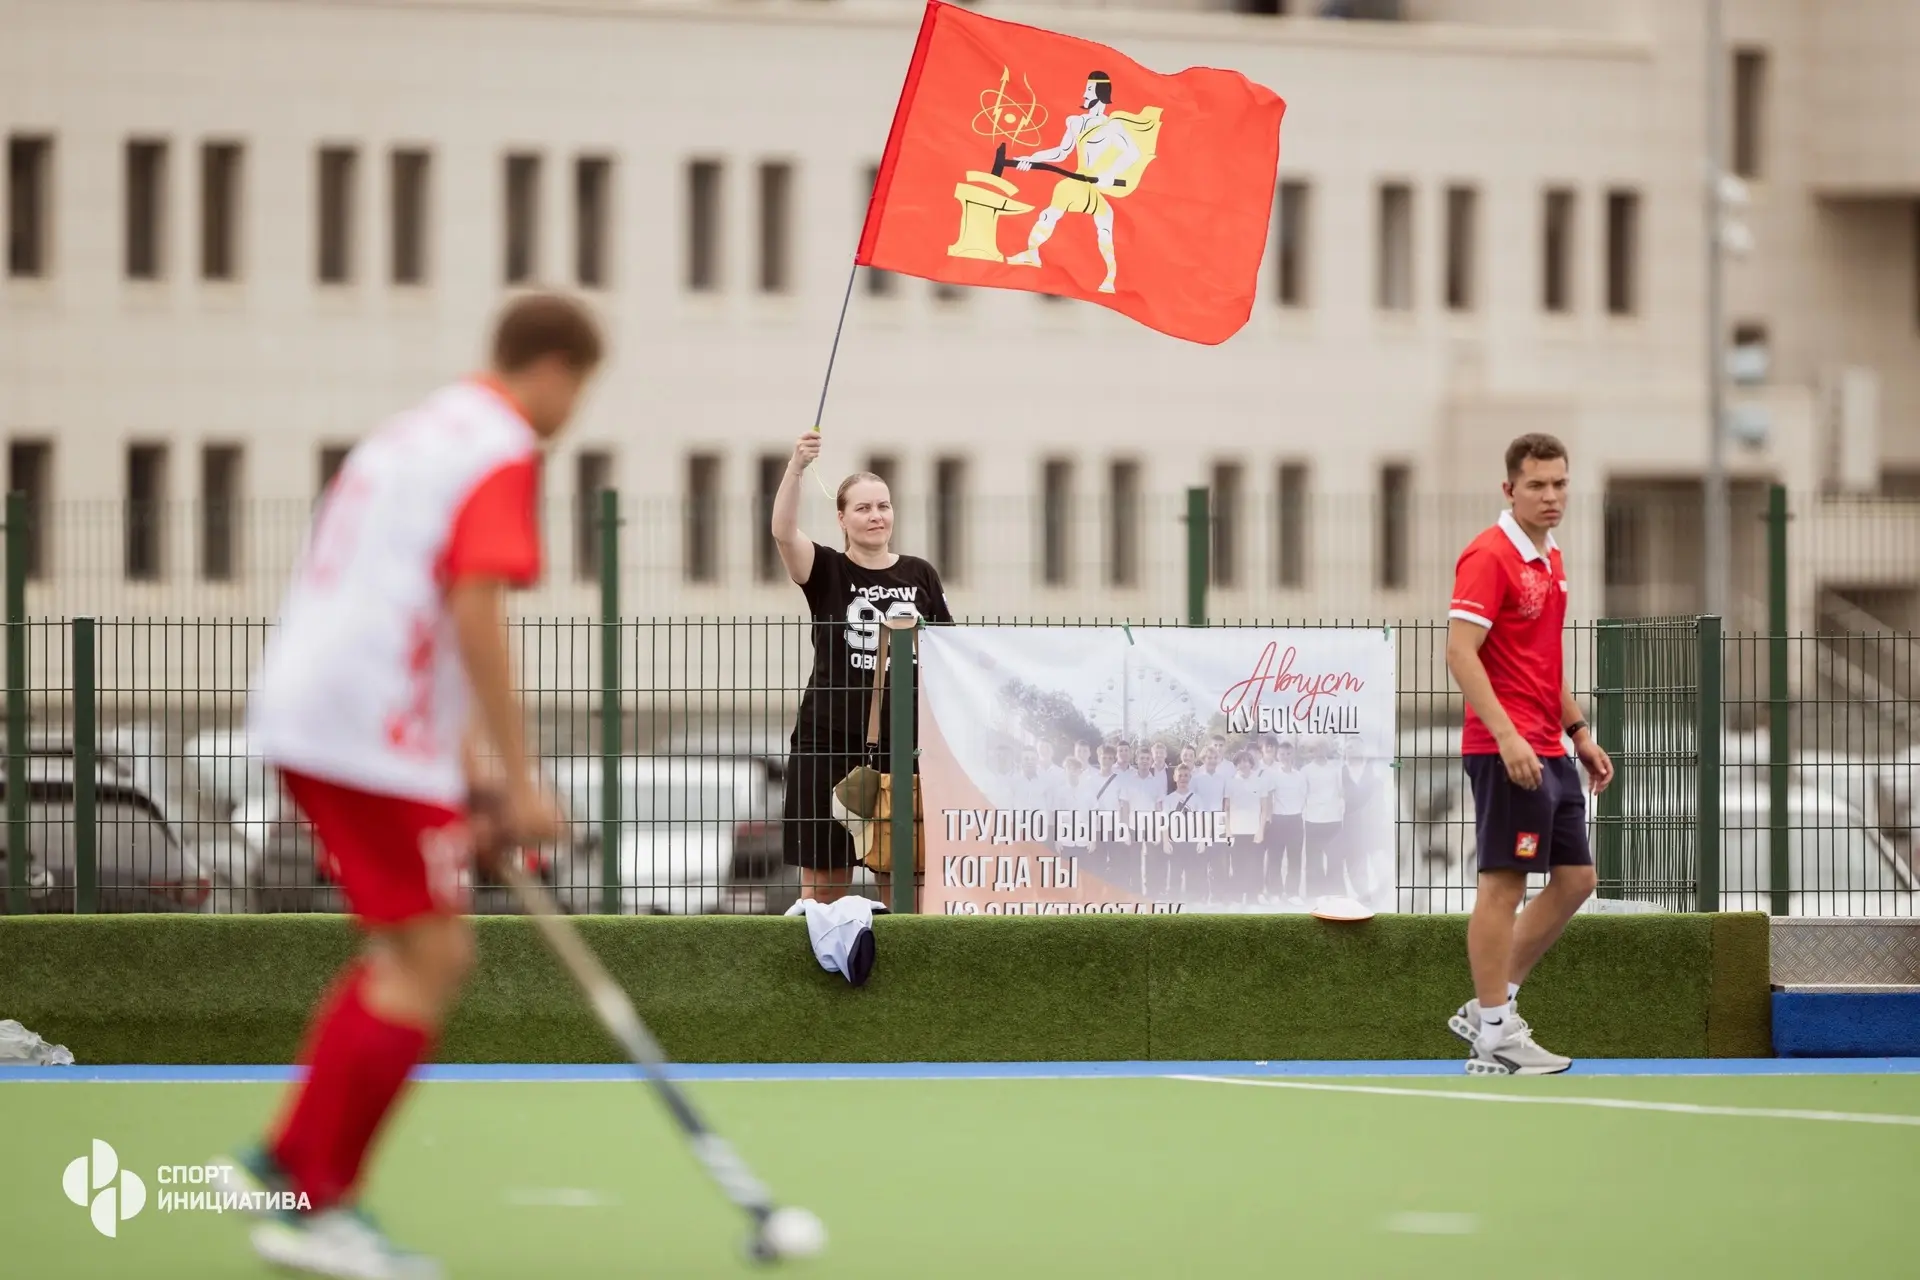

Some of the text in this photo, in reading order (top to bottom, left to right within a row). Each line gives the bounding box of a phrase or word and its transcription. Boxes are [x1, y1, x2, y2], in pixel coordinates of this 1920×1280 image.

[850, 583, 918, 602] OSCOW
[1220, 641, 1365, 721] Август
[1226, 705, 1360, 734] КУБОК НАШ
[942, 809, 1235, 847] ТРУДНО БЫТЬ ПРОЩЕ,
[942, 855, 1078, 892] КОГДА ТЫ
